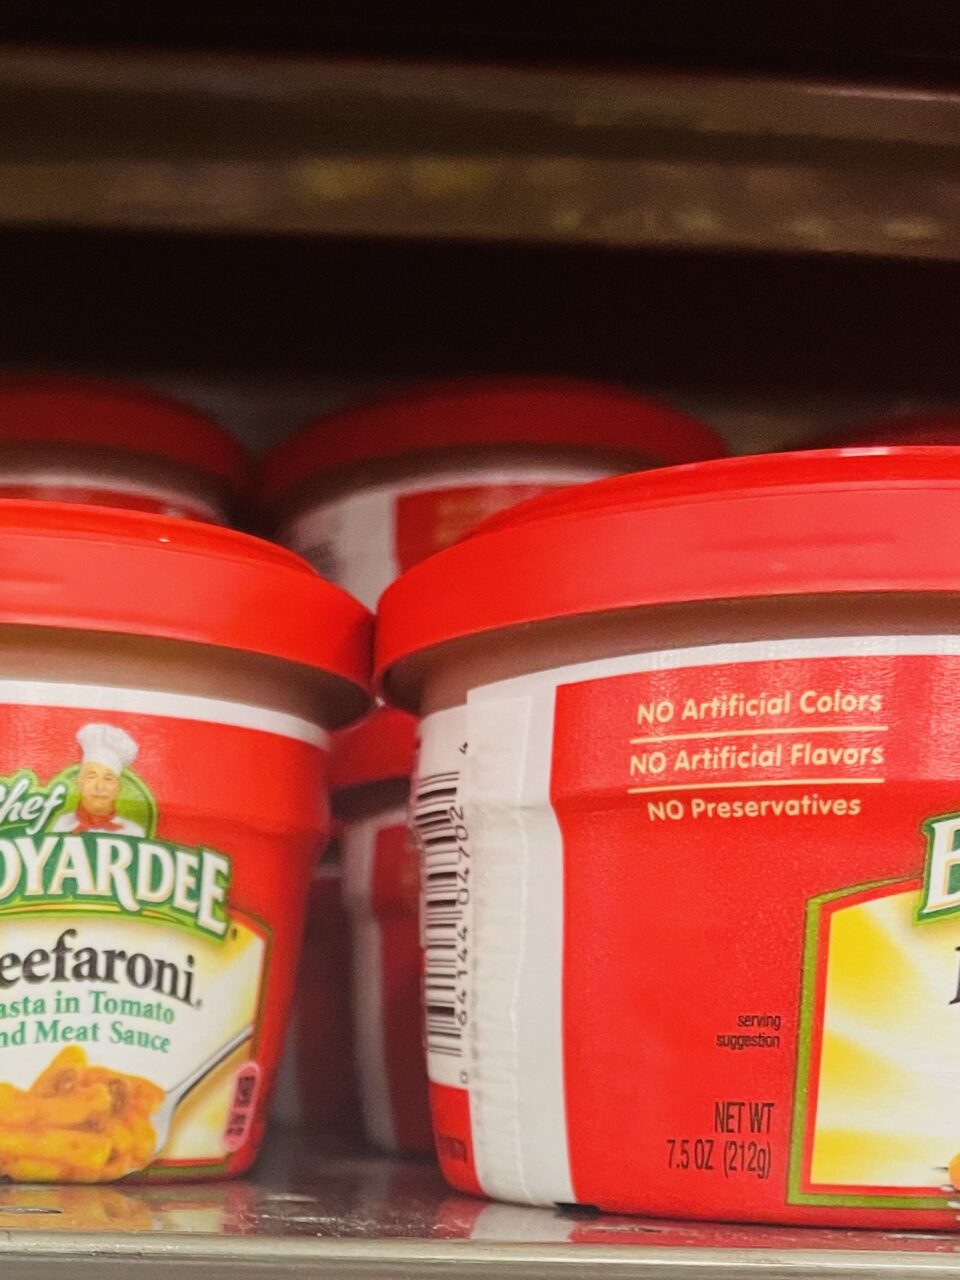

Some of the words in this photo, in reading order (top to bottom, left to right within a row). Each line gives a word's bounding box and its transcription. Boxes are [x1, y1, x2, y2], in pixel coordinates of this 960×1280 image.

[637, 700, 674, 724] NO
[682, 692, 790, 720] Artificial
[799, 689, 883, 714] Colors
[629, 752, 667, 776] NO
[674, 744, 782, 771] Artificial
[791, 742, 884, 767] Flavors
[647, 799, 684, 821] NO
[691, 793, 861, 818] Preservatives
[56, 990, 81, 1015] in
[88, 991, 176, 1024] Tomato
[737, 1013, 782, 1031] serving
[34, 1020, 100, 1045] Meat
[110, 1021, 171, 1053] Sauce
[716, 1032, 780, 1050] suggestion
[714, 1101, 745, 1133] NET
[749, 1102, 775, 1134] WT
[667, 1139, 690, 1169] 7.5
[694, 1138, 714, 1170] OZ
[723, 1140, 772, 1180] (212g)
